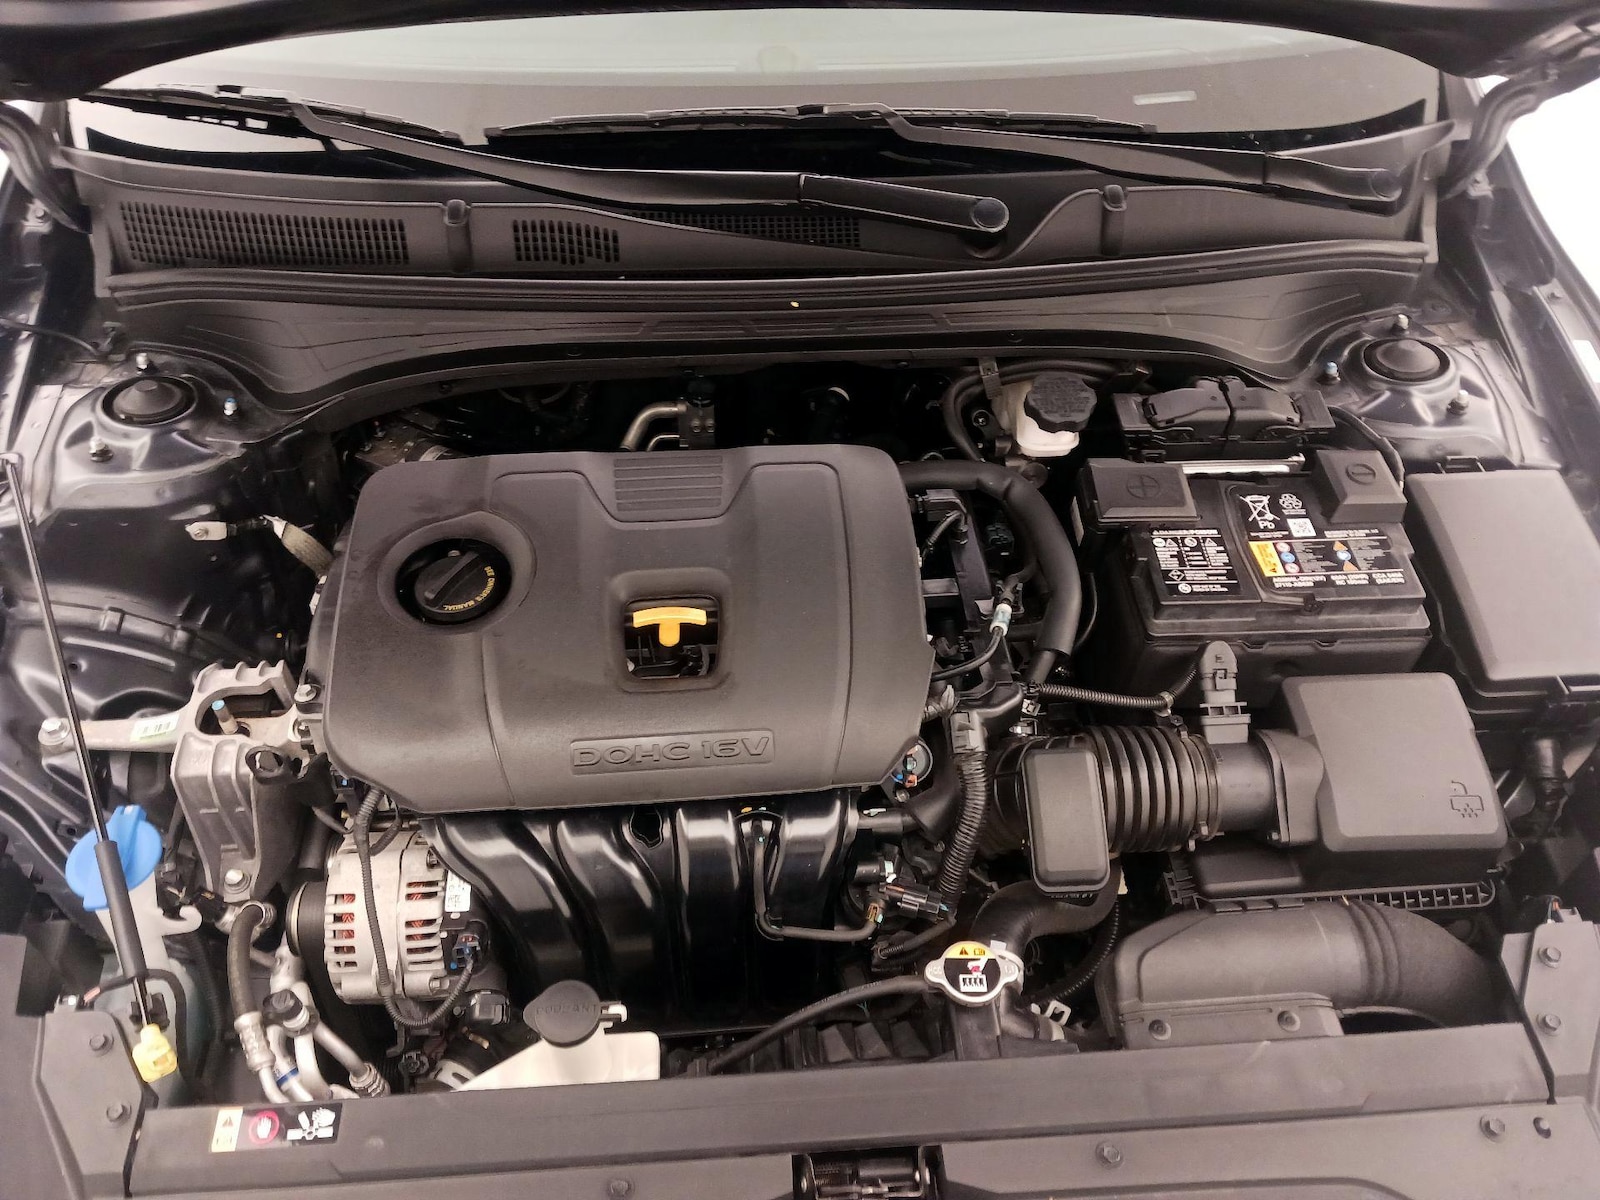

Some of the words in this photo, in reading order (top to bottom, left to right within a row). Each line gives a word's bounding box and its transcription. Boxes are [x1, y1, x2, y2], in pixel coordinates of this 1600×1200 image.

[1258, 520, 1275, 530] Pb
[443, 600, 475, 611] MANUAL
[573, 741, 691, 768] DOHC
[701, 736, 770, 759] 16V
